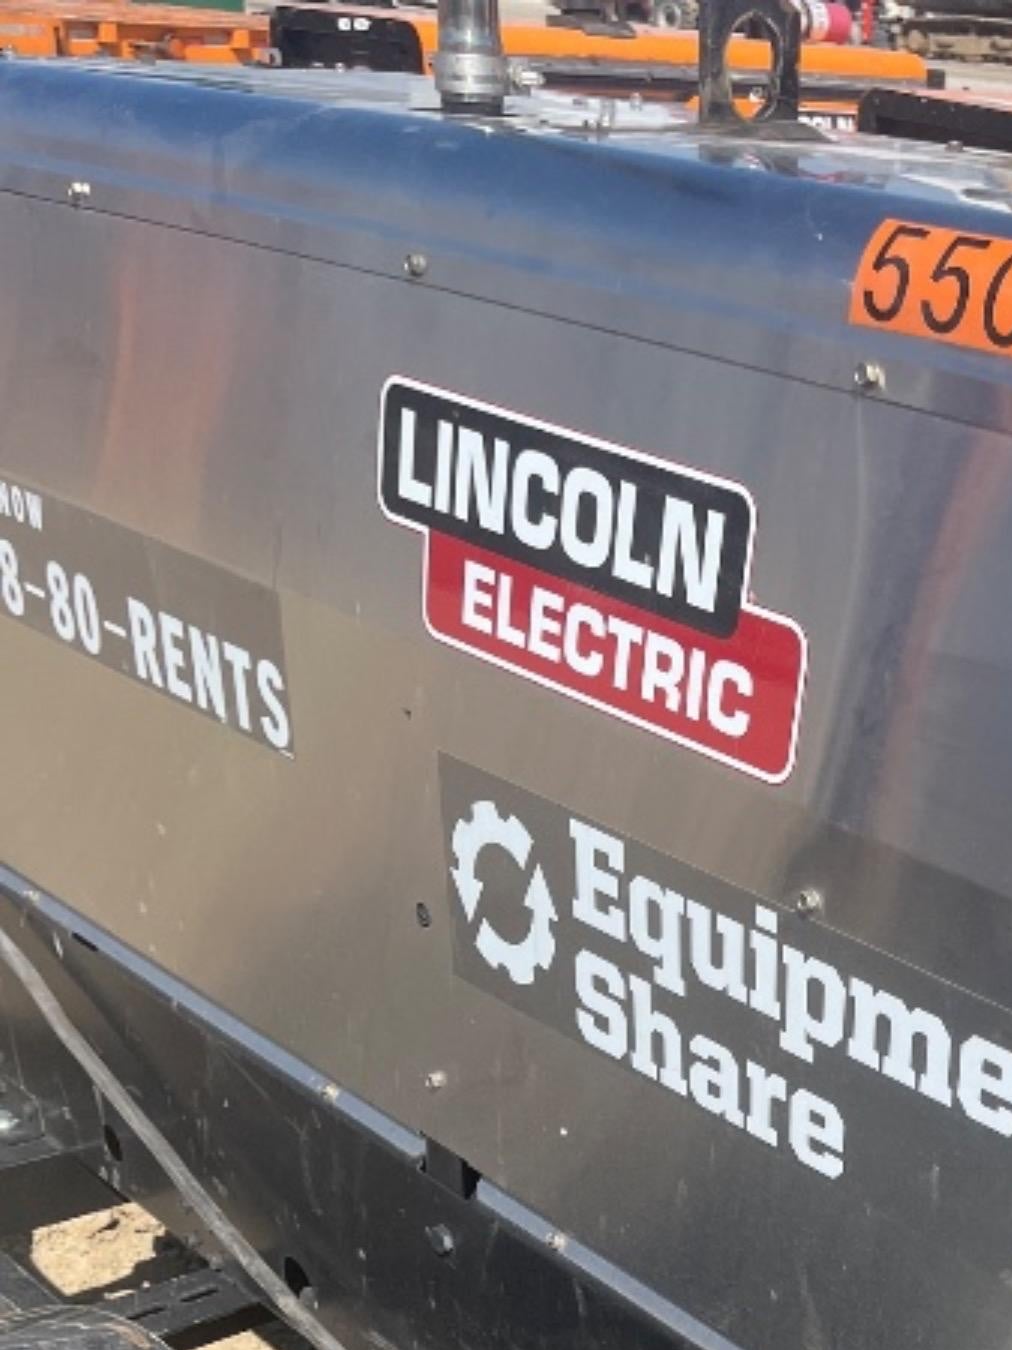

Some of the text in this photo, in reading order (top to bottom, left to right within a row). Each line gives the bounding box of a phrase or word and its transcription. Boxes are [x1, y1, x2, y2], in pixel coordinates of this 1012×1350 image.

[398, 407, 726, 613] LINCOLN
[461, 559, 754, 738] ELECTRIC
[574, 949, 845, 1180] Share
